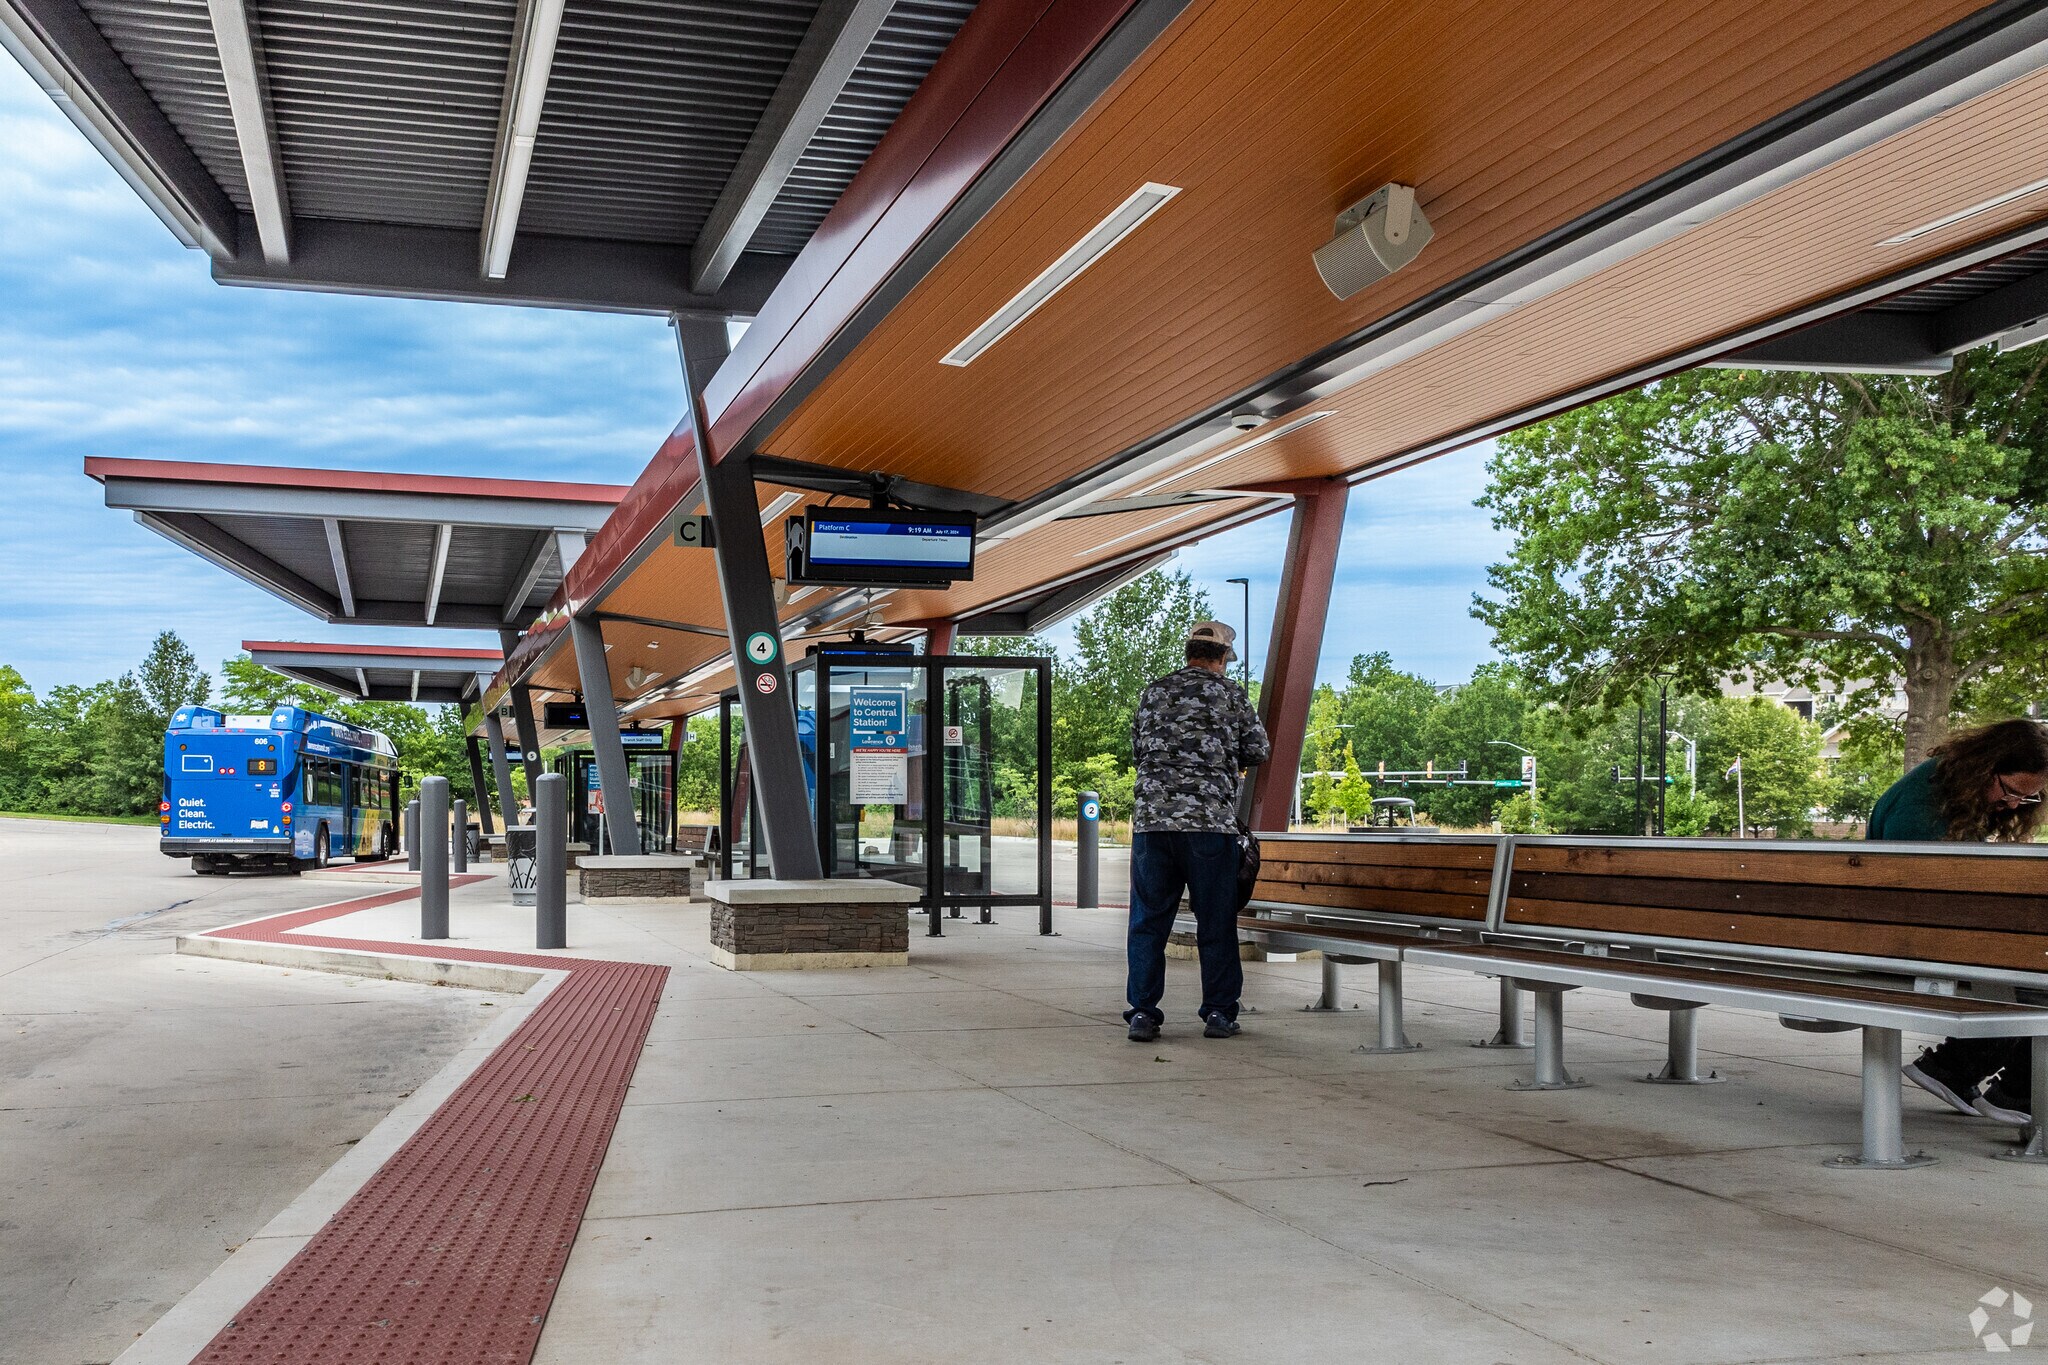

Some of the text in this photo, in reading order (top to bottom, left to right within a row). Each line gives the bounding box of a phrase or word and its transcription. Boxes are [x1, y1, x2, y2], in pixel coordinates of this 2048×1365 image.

[680, 521, 697, 542] C
[818, 524, 844, 532] Platform
[756, 641, 767, 654] 4
[853, 698, 897, 707] Welcome
[501, 707, 508, 716] B
[853, 708, 898, 717] to Central
[853, 718, 888, 727] Station!
[258, 760, 266, 771] 8
[178, 797, 207, 807] Quiet.
[178, 809, 207, 818] Clean.
[1089, 806, 1095, 815] 2
[178, 820, 216, 829] Electric.
